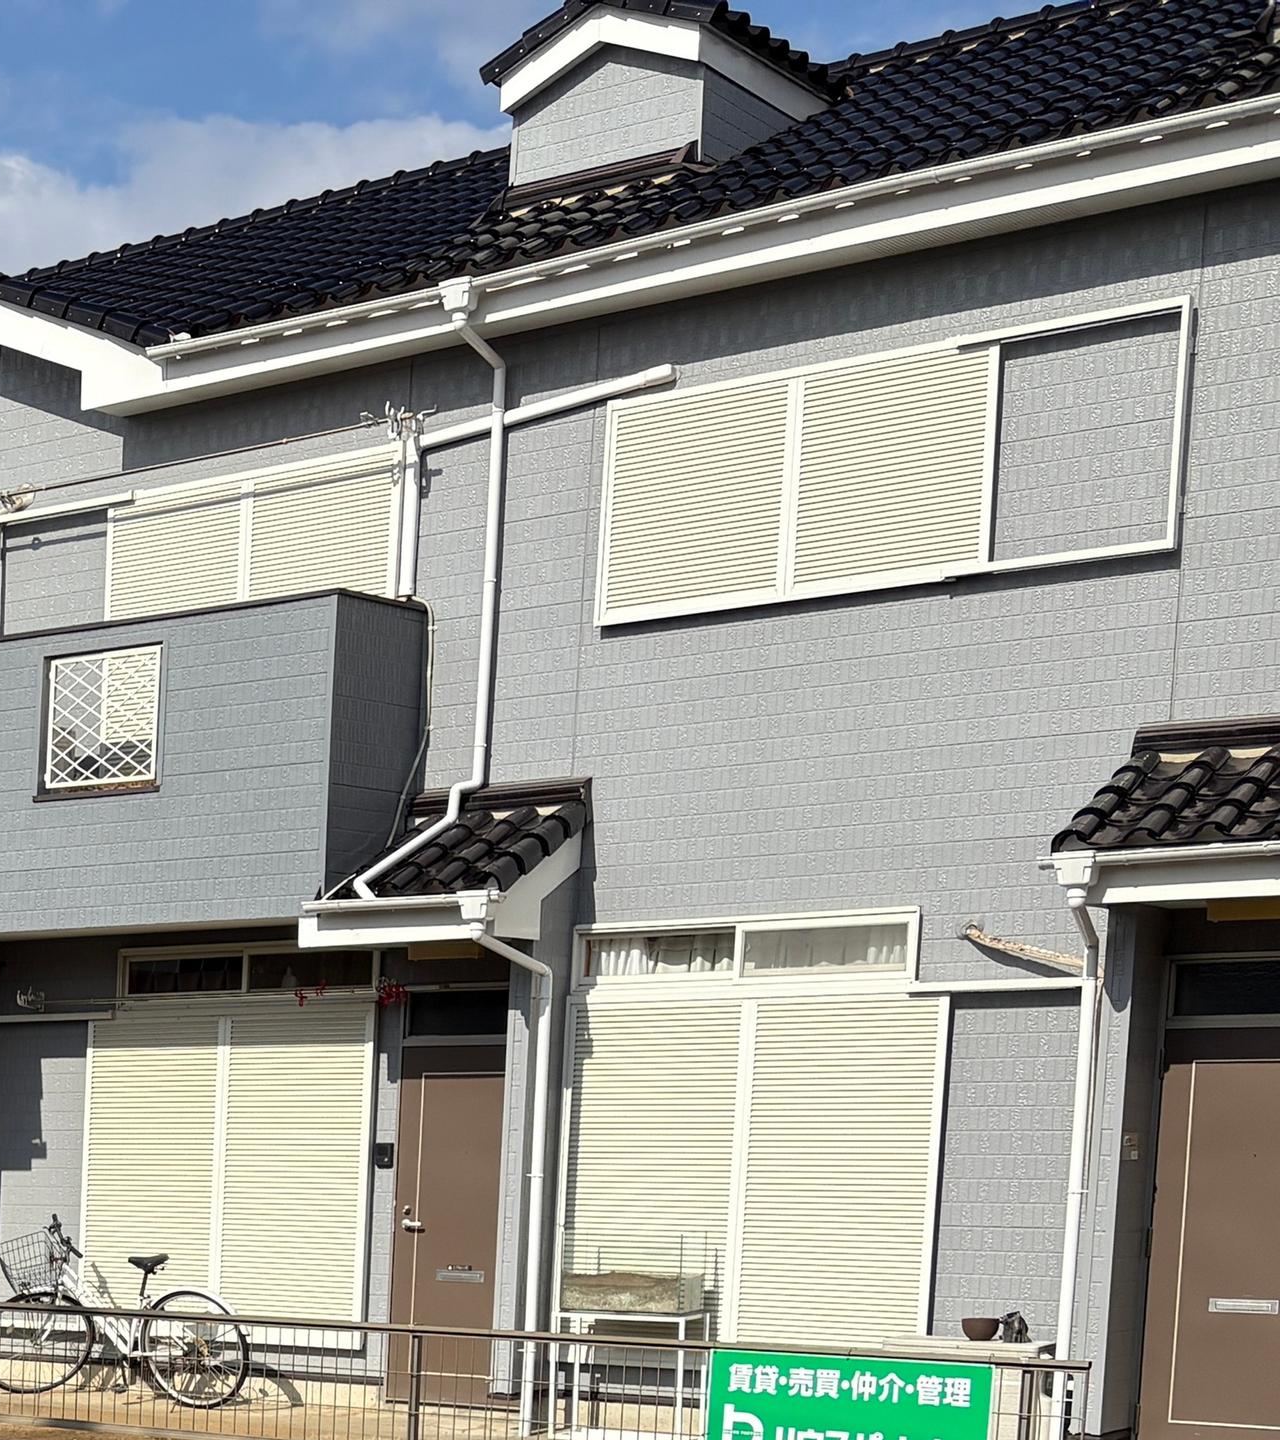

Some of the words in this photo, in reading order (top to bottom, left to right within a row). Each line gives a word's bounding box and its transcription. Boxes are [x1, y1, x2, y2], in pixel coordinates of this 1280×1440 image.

[727, 1362, 972, 1408] 賃貸・売買・仲介・管理
